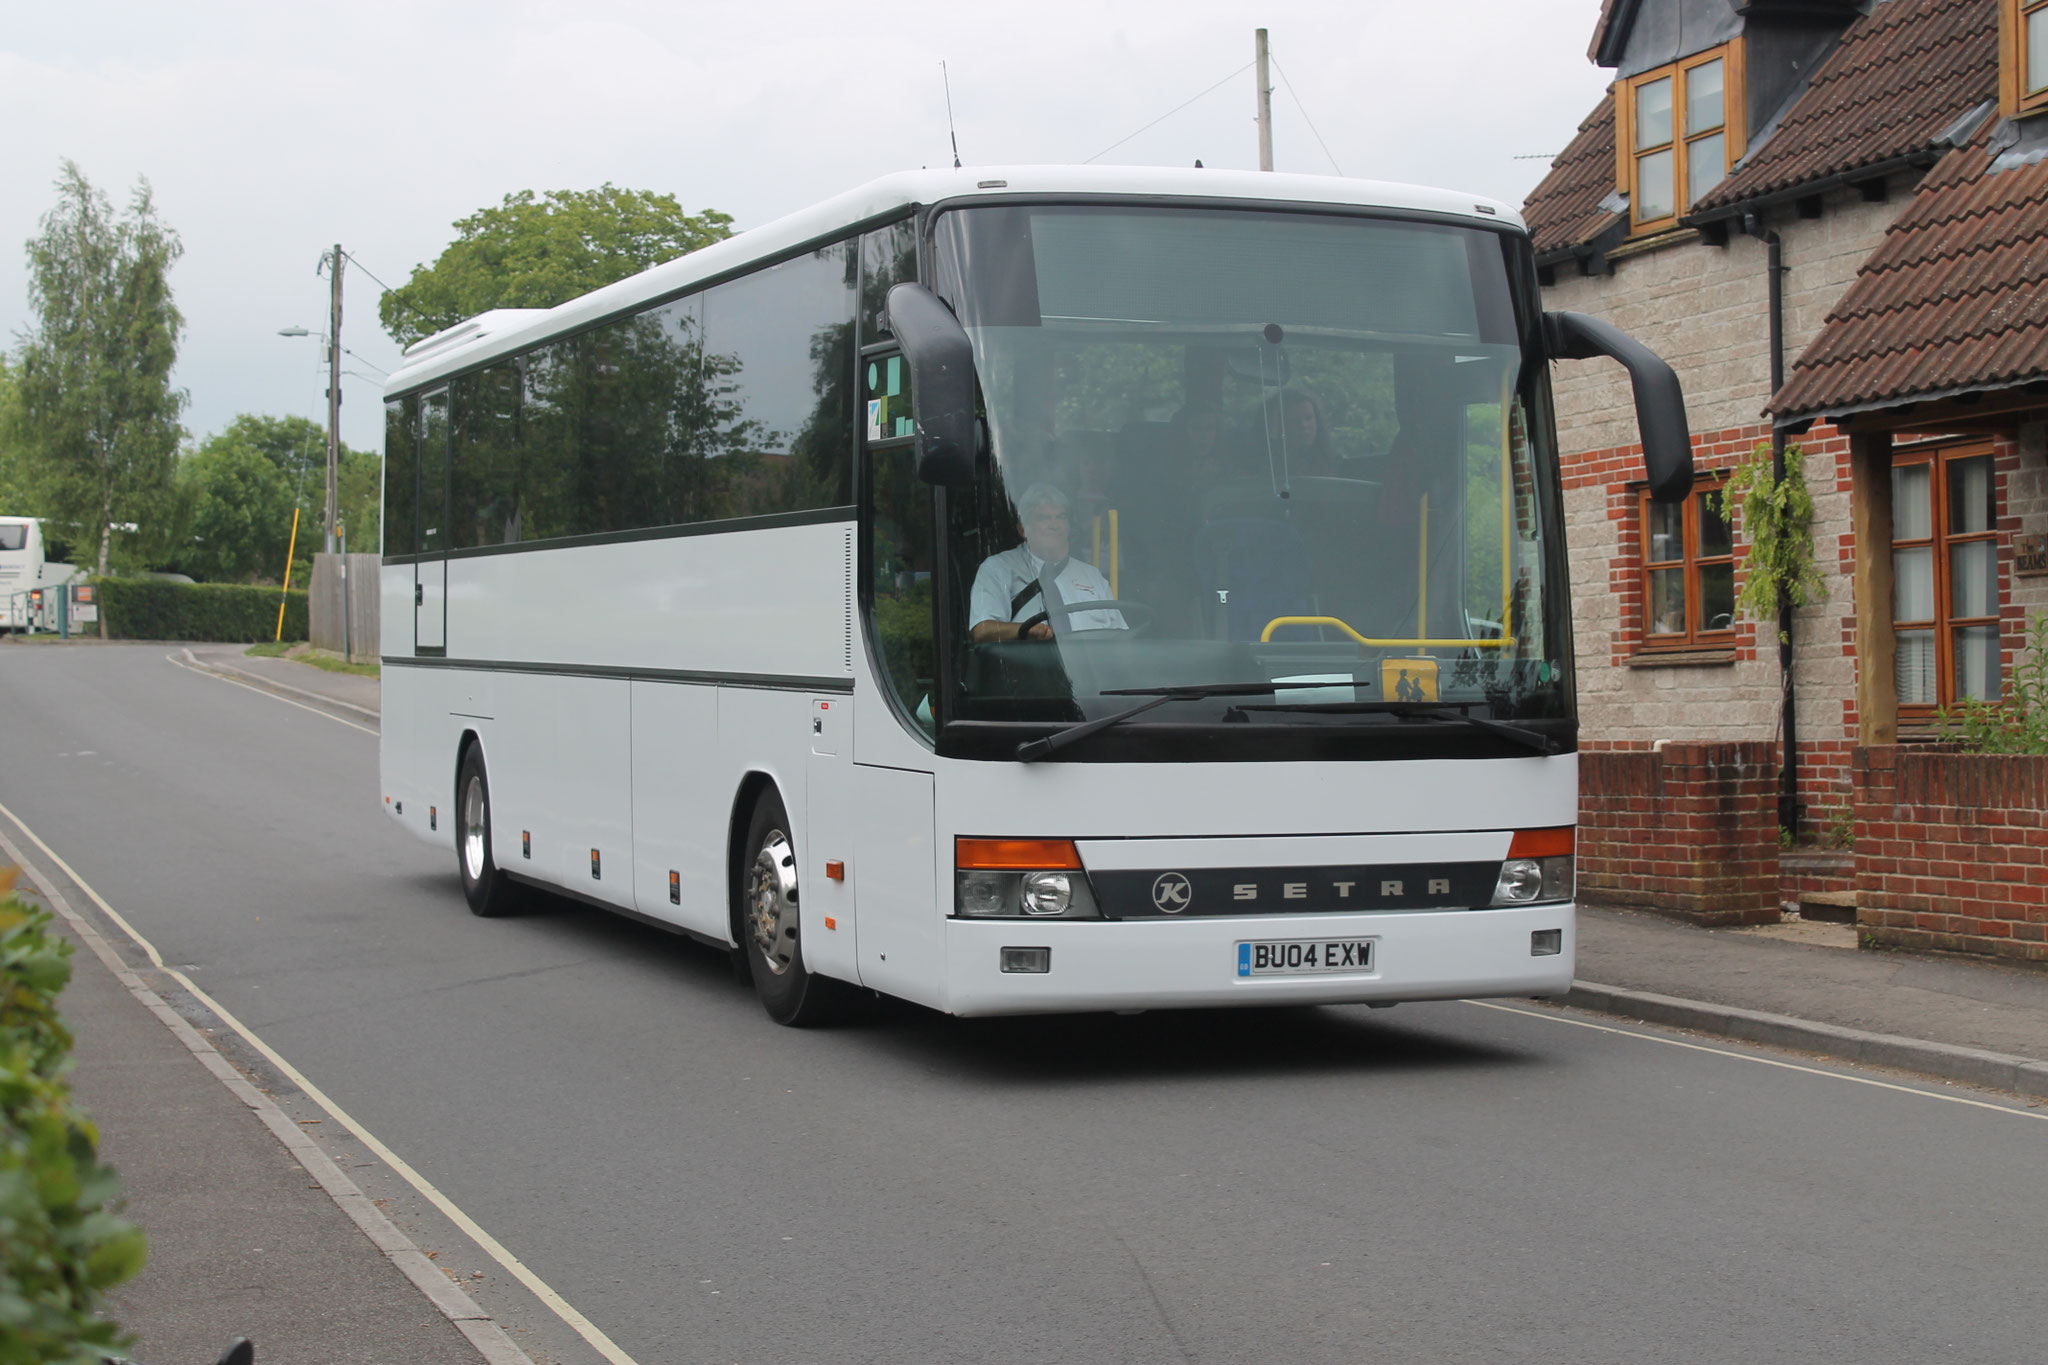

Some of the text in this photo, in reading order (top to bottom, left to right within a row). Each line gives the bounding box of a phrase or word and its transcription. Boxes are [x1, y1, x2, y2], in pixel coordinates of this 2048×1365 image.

[1233, 878, 1450, 900] SETRA
[1254, 942, 1371, 968] BU04 EXW
